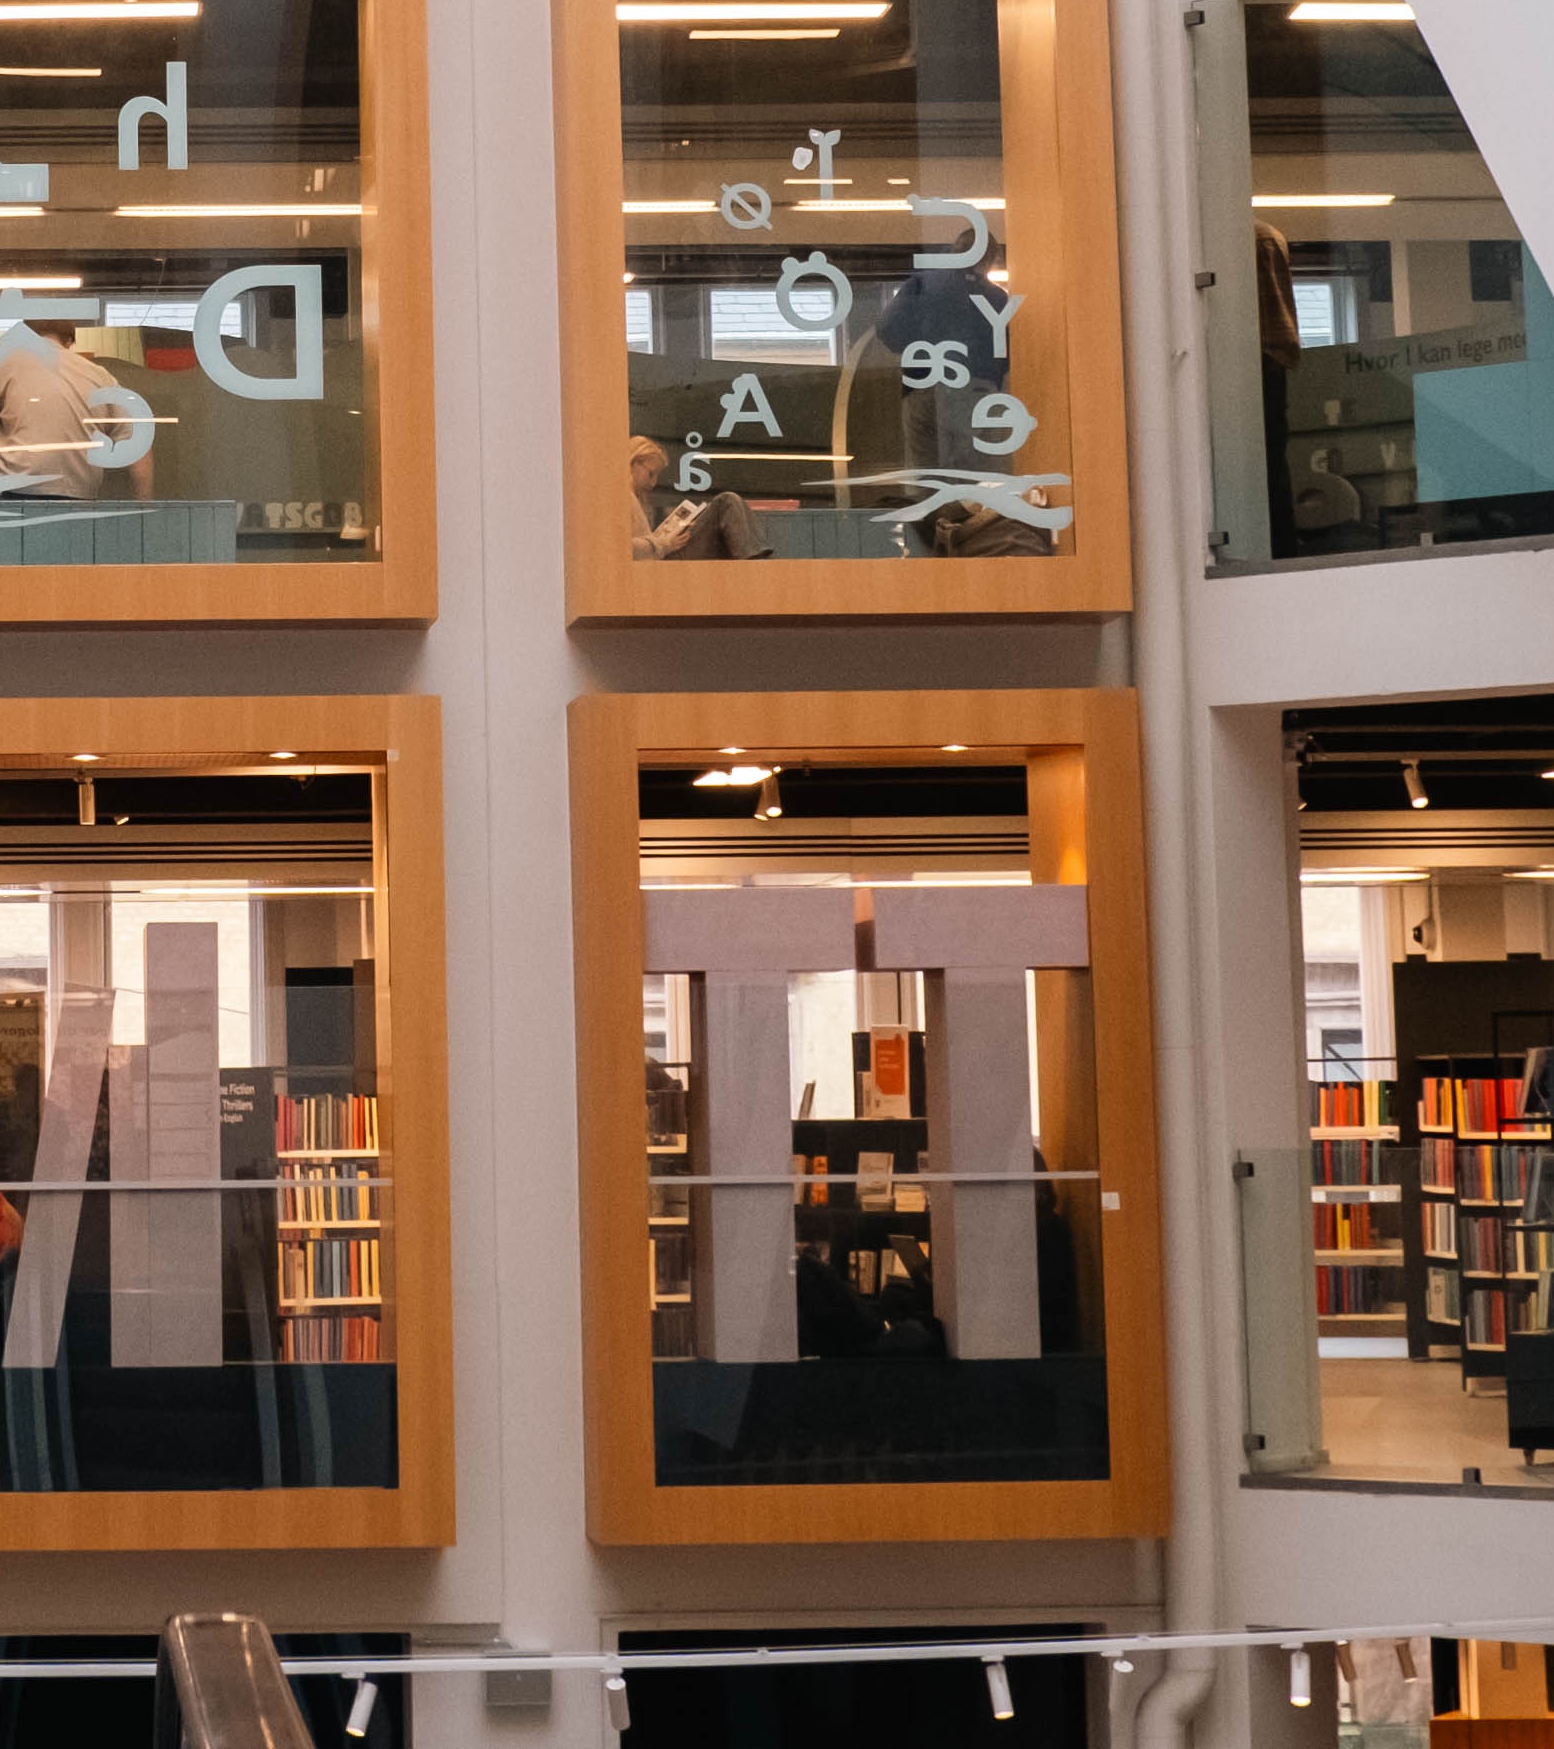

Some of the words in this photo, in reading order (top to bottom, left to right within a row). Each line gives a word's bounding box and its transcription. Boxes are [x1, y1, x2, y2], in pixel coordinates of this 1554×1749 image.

[1345, 351, 1399, 374] Hvor
[1417, 343, 1452, 364] kan
[1457, 339, 1493, 362] lege
[228, 1083, 256, 1095] Fiction
[222, 1098, 254, 1112] Thrillers
